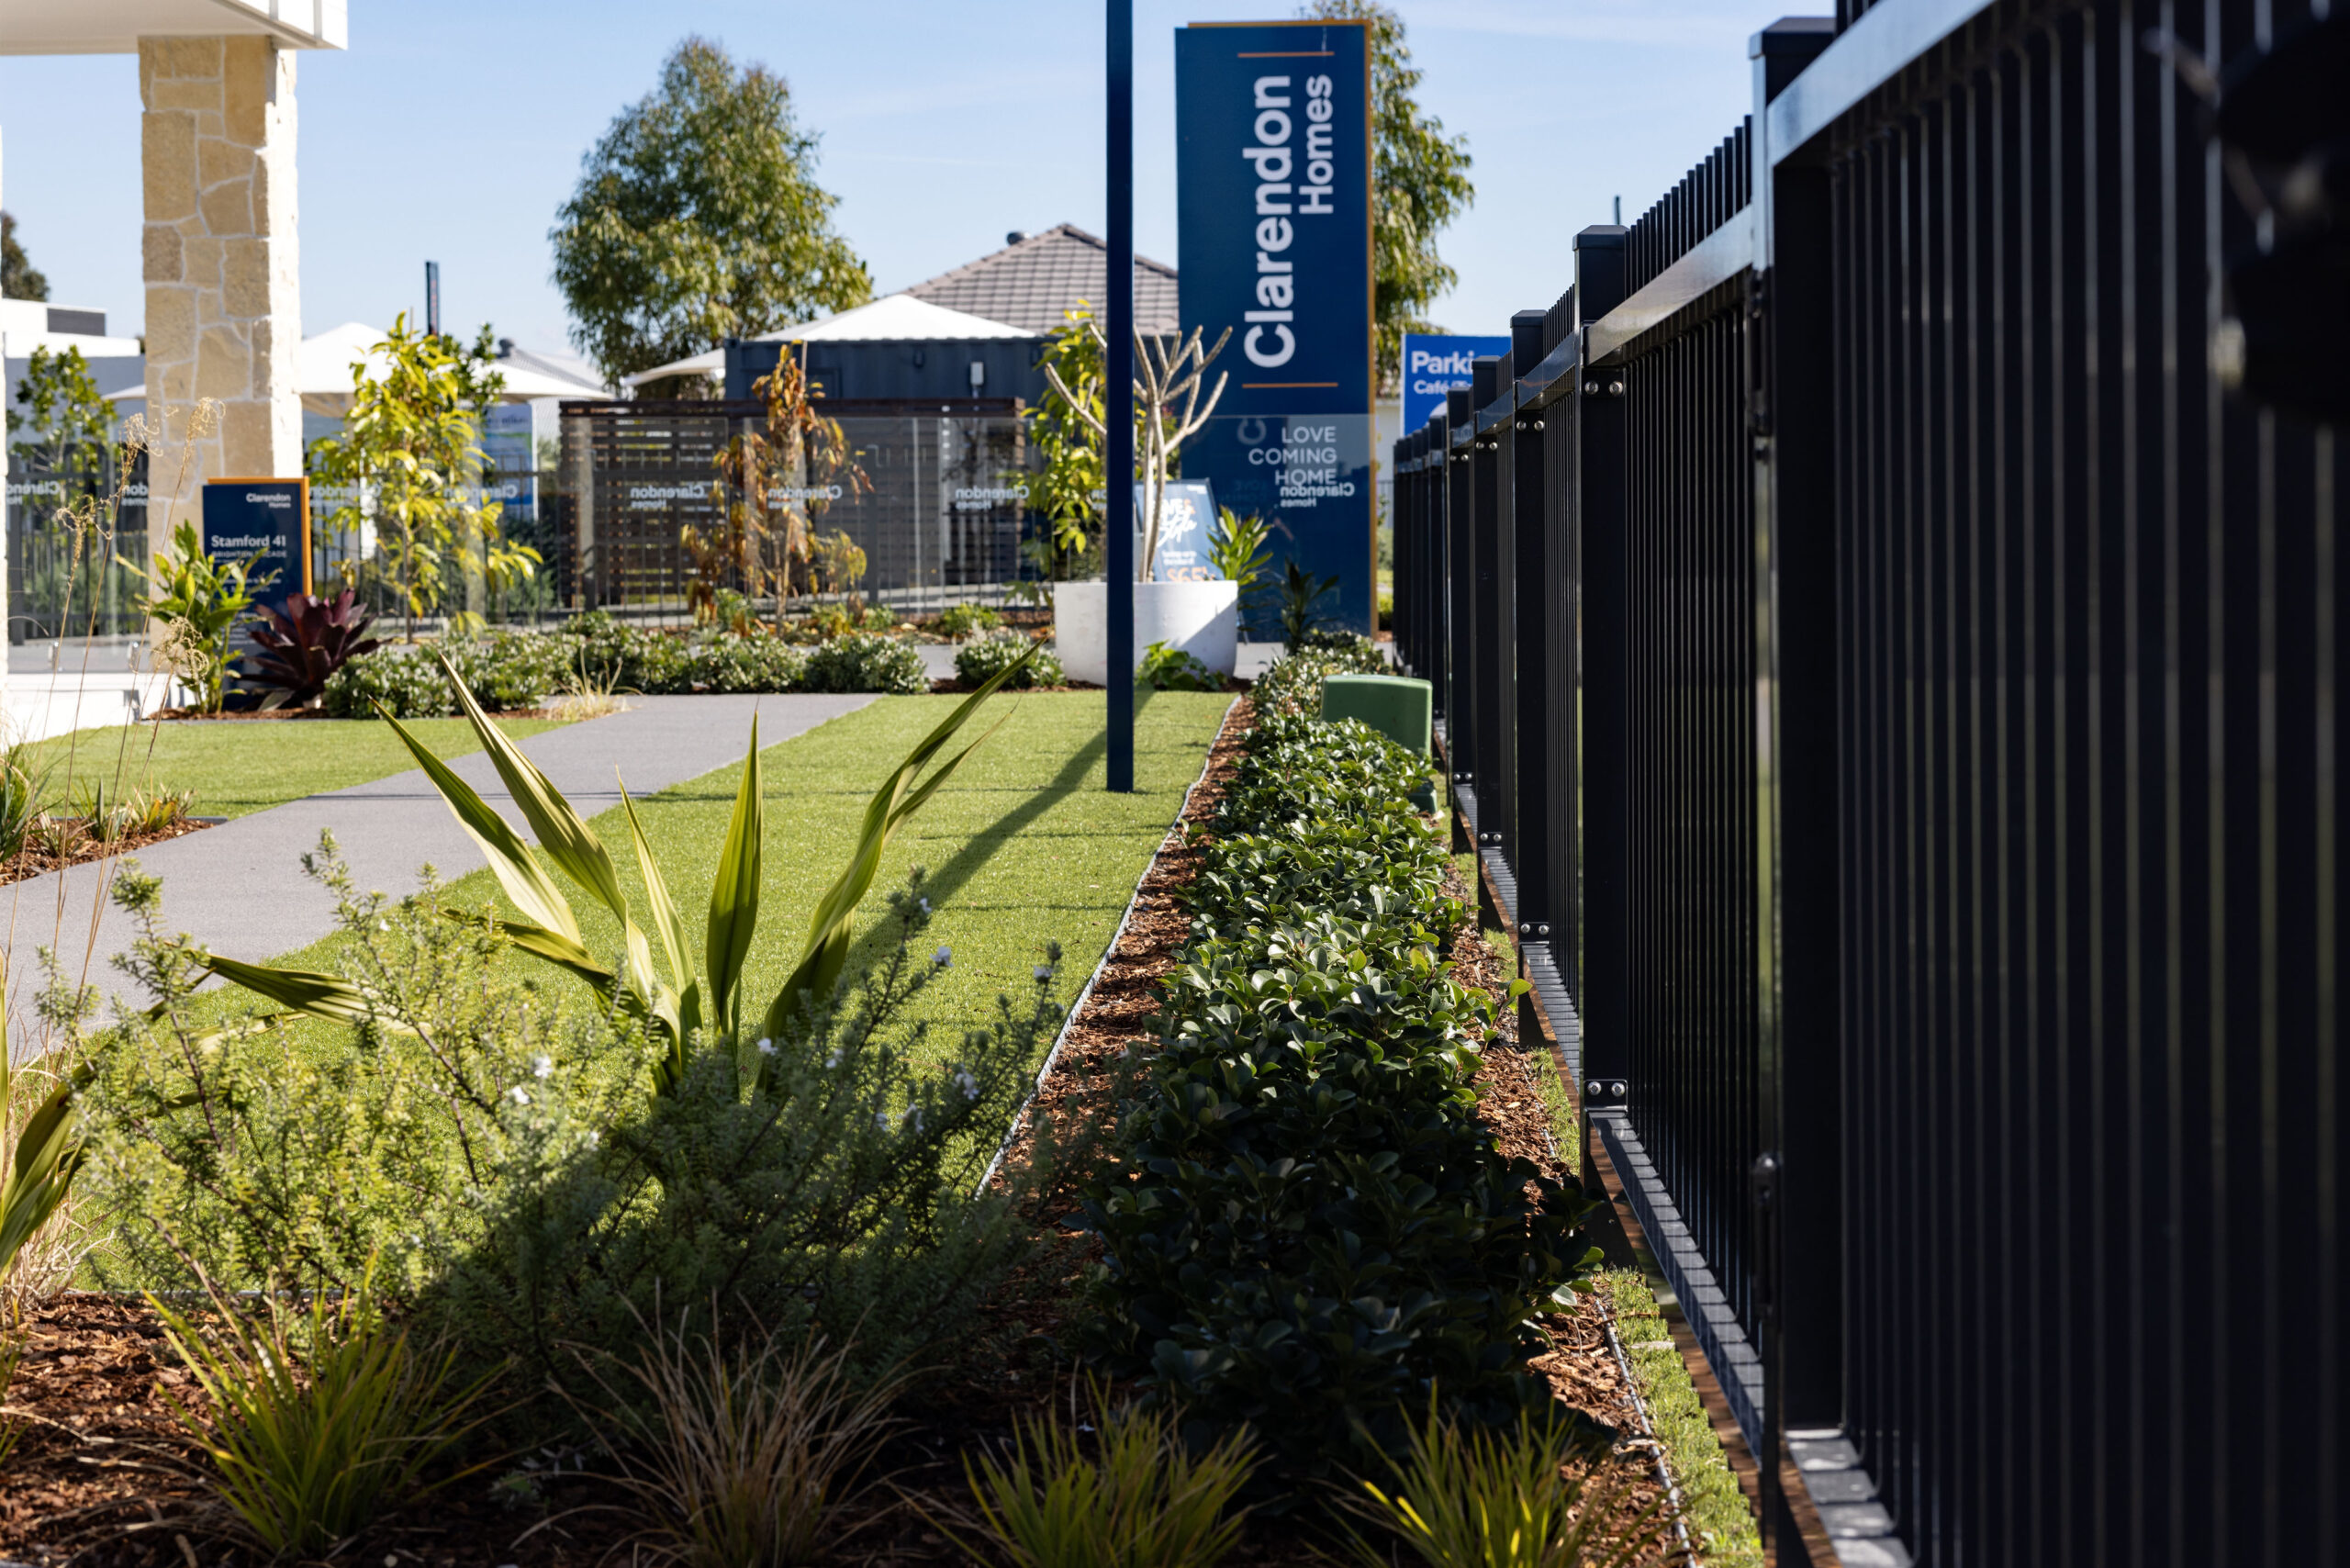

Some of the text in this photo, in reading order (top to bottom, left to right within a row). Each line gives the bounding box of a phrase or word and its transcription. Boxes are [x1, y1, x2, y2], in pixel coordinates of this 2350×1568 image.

[1299, 74, 1333, 214] Homes
[1243, 75, 1295, 368] Clarendon
[1411, 351, 1474, 375] Parki
[1281, 426, 1337, 443] LOVE
[1248, 447, 1337, 465] COMING
[1274, 468, 1337, 486] HOME
[246, 493, 291, 503] Clarendon
[211, 535, 286, 548] Stamford 41
